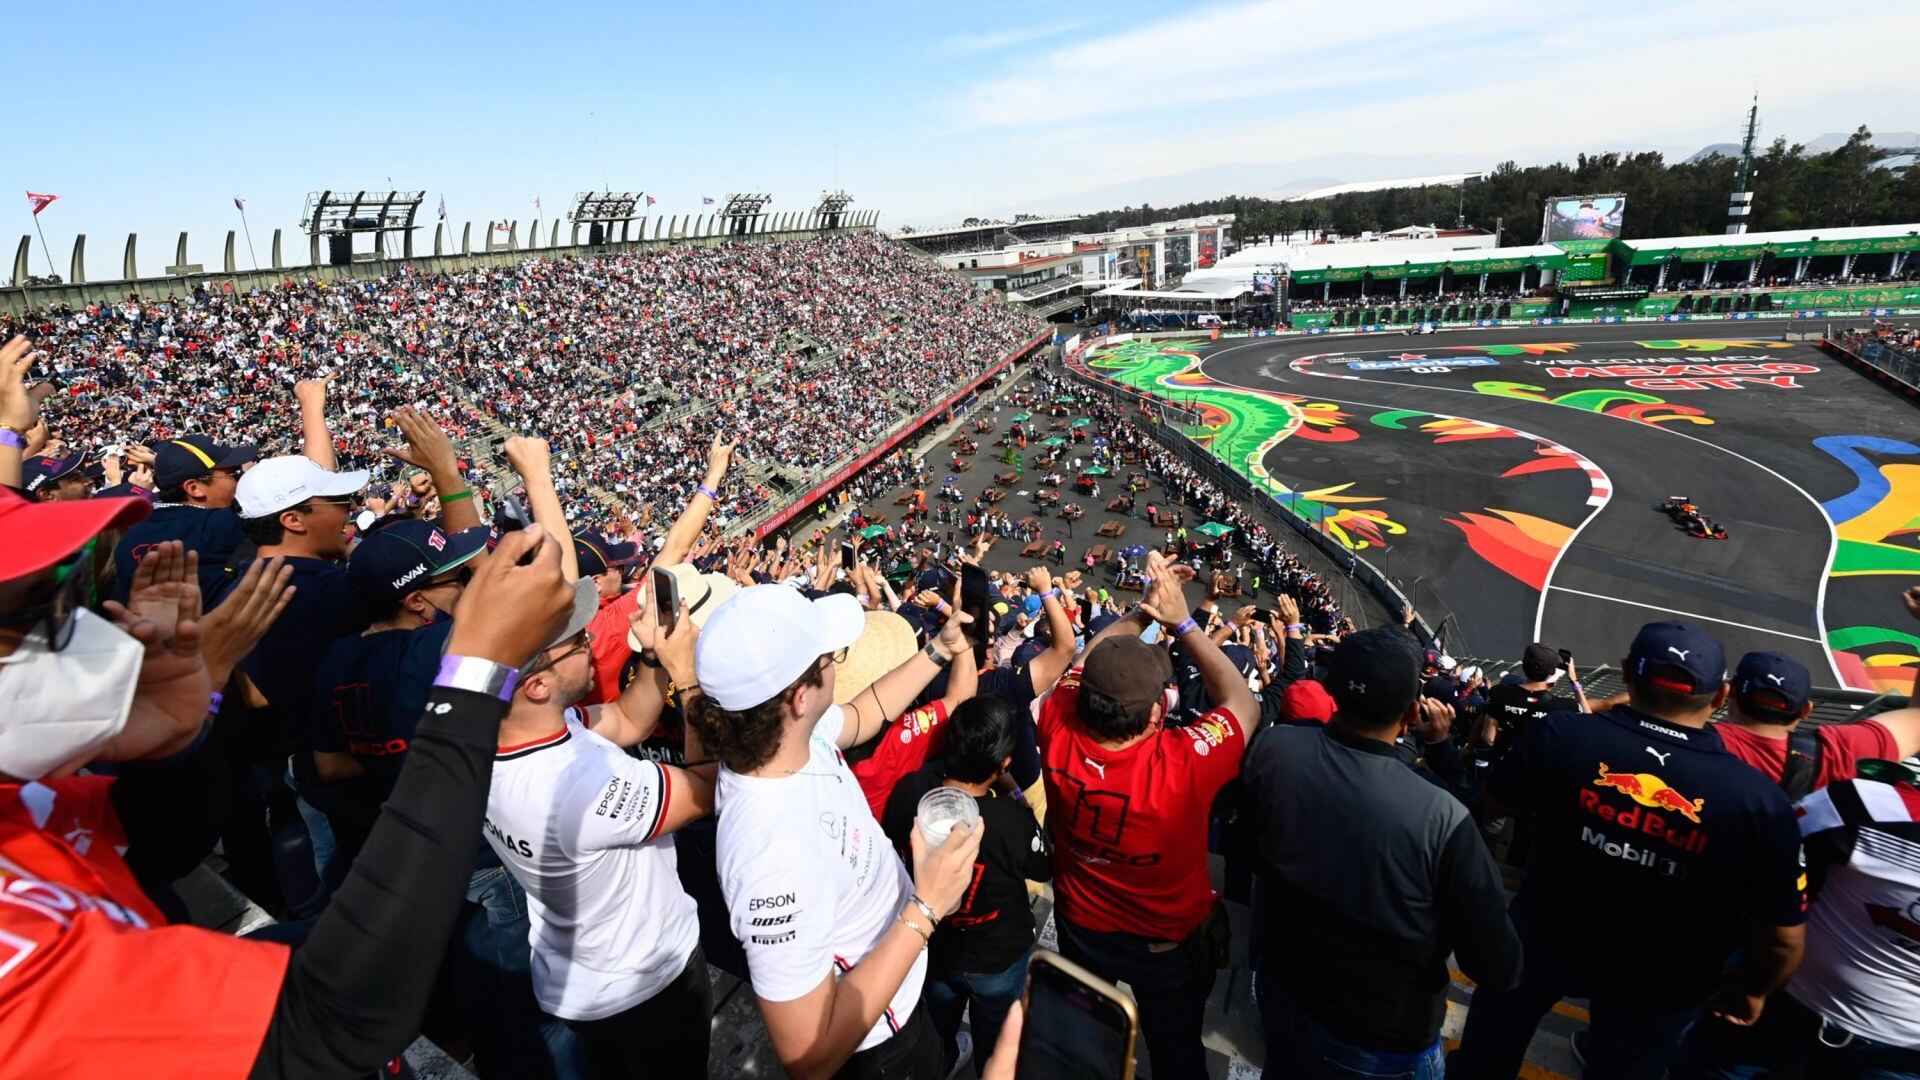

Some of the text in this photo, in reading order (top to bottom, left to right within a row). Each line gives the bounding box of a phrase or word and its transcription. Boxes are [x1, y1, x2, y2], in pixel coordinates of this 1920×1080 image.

[1358, 357, 1489, 370] Heineken
[1523, 358, 1679, 366] WELCOME
[1545, 362, 1822, 378] MEXICO
[1625, 375, 1804, 391] CITY
[428, 530, 446, 552] 11
[392, 562, 428, 589] KAVAK
[1640, 720, 1688, 742] HONDA
[596, 776, 620, 816] EPSON
[610, 781, 632, 819] PIRELLI
[1579, 787, 1710, 855] Red Bull
[1581, 826, 1656, 868] Mobil
[749, 892, 796, 911] EPSON
[752, 914, 797, 926] BOSE
[751, 930, 796, 945] PIRELLI
